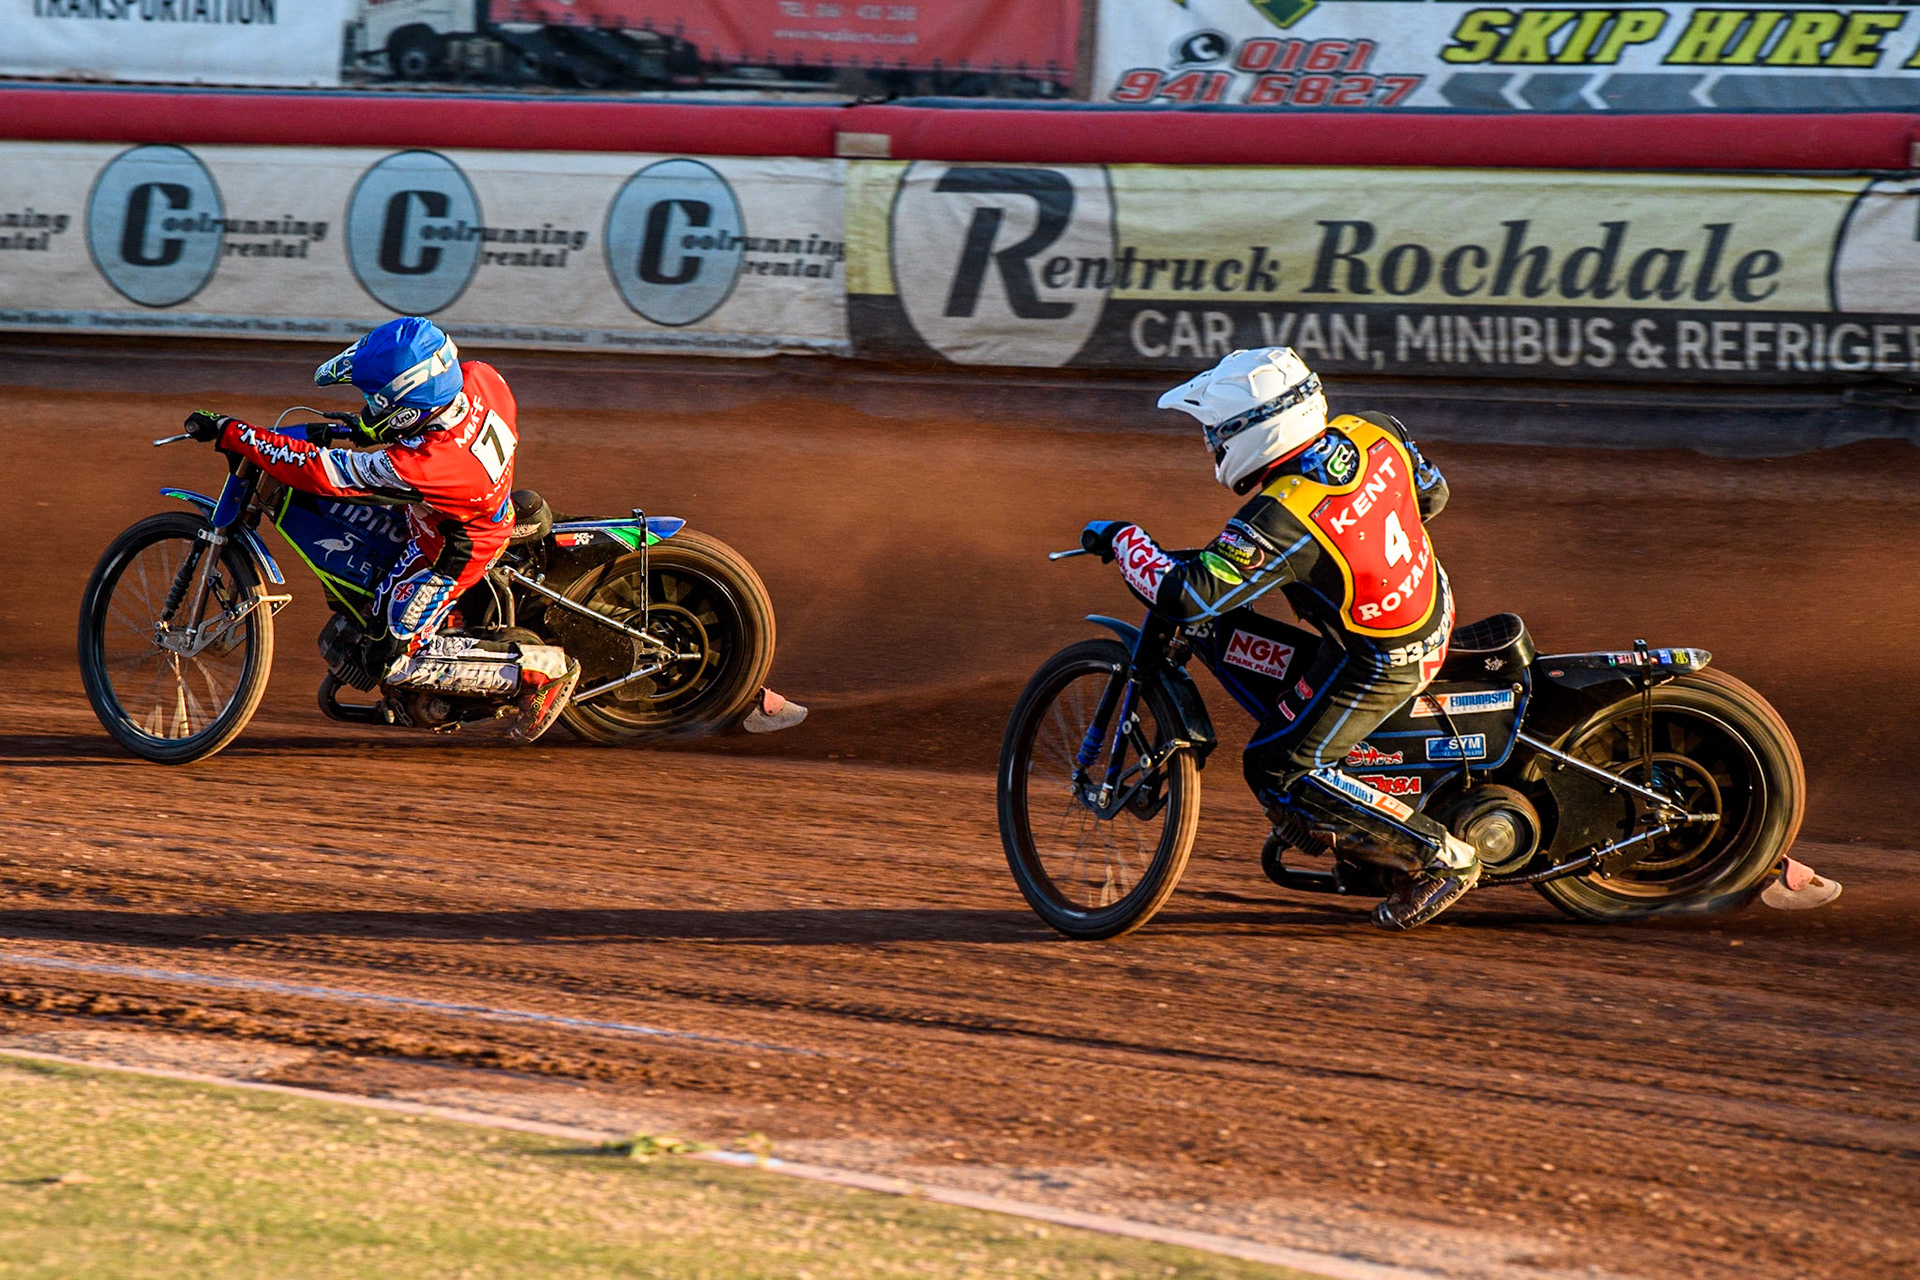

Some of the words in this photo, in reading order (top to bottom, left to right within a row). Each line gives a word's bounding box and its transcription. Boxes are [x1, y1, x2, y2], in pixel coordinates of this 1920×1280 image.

[1234, 37, 1378, 73] 0161
[1439, 8, 1669, 65] SKIP
[1660, 9, 1908, 69] HIRE
[1110, 68, 1234, 103] 941
[1243, 72, 1426, 107] 6827
[742, 258, 834, 280] rental
[1304, 219, 1782, 304] Rochdale
[1130, 309, 1235, 358] CAR
[1396, 315, 1616, 368] MINIBUS
[1626, 318, 1667, 370] &
[481, 423, 506, 467] 7
[1329, 456, 1397, 535] KENT
[1116, 527, 1170, 587] NGK
[1384, 509, 1413, 568] 4
[1358, 535, 1431, 621] ROYALS
[1226, 653, 1253, 668] SPARK
[1254, 663, 1284, 678] PLUGS
[1228, 632, 1292, 669] NGK
